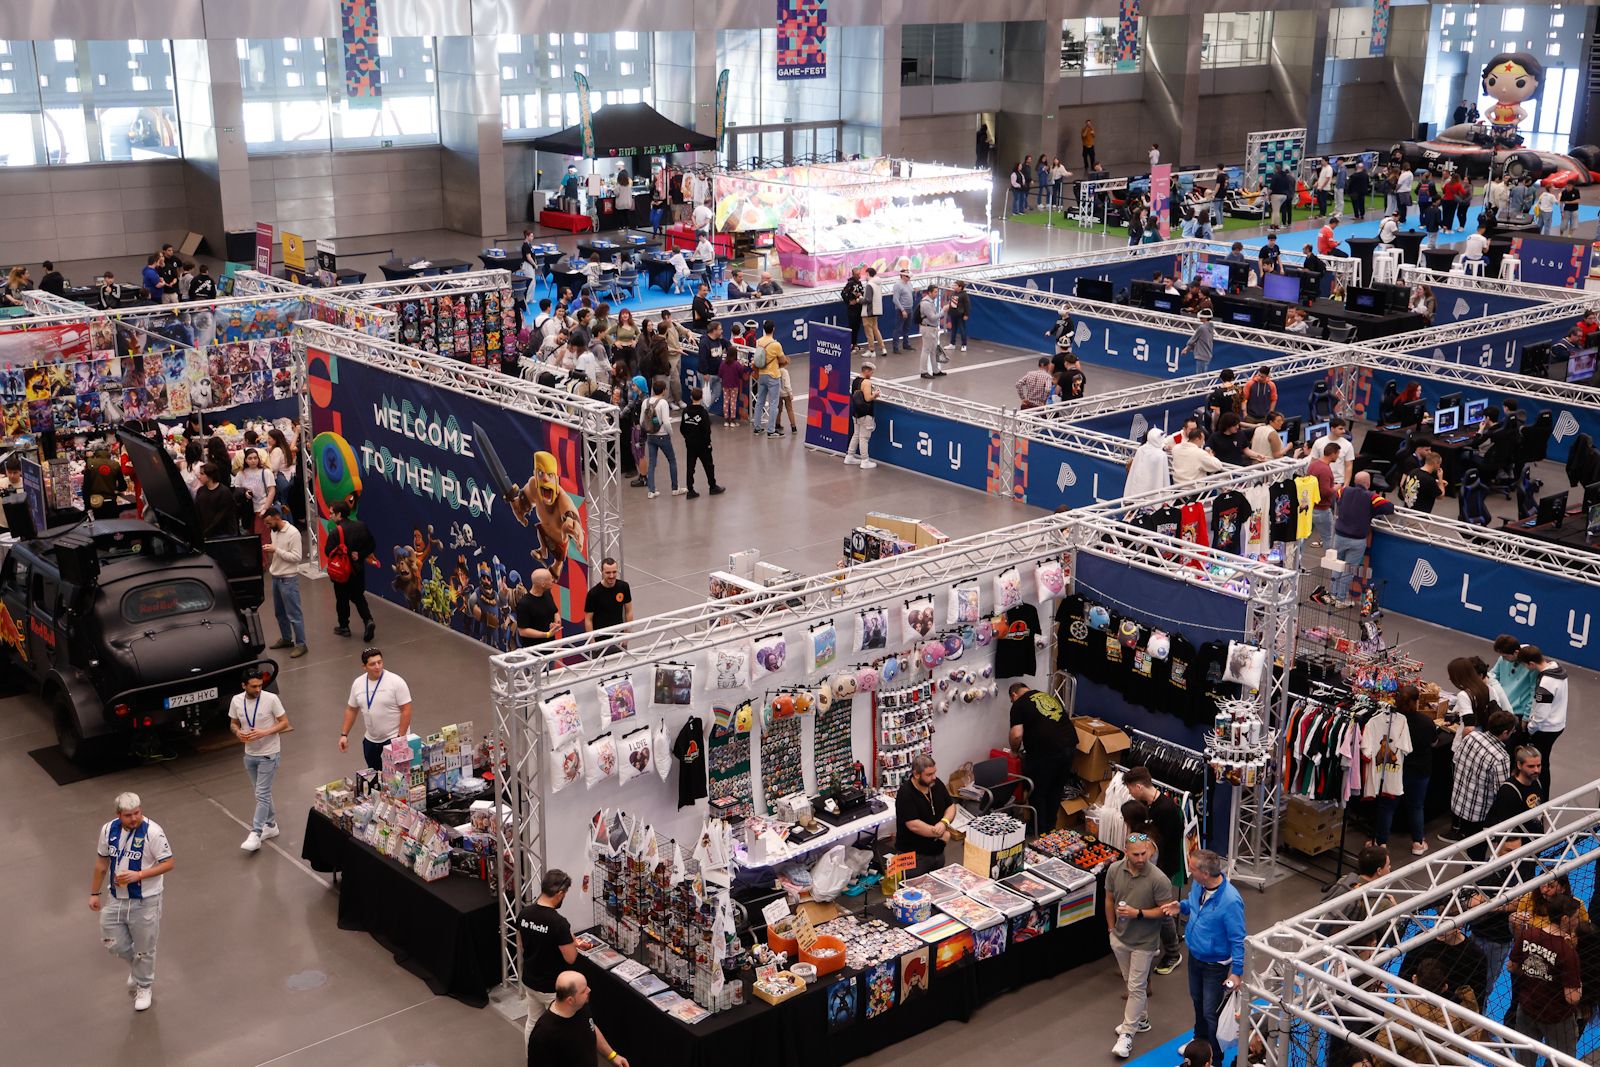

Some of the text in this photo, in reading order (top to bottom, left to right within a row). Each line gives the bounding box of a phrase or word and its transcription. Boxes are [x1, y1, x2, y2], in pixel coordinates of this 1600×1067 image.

[778, 67, 825, 76] GAME-FEST
[816, 340, 842, 351] VIRTUAL
[816, 346, 842, 357] REALITY
[373, 403, 475, 458] WELCOME
[360, 445, 497, 515] TO THE PLAY
[31, 615, 56, 648] Red Bull
[171, 689, 215, 706] 7743 HYC
[633, 739, 648, 750] LOVE
[521, 919, 549, 933] Be Tech!
